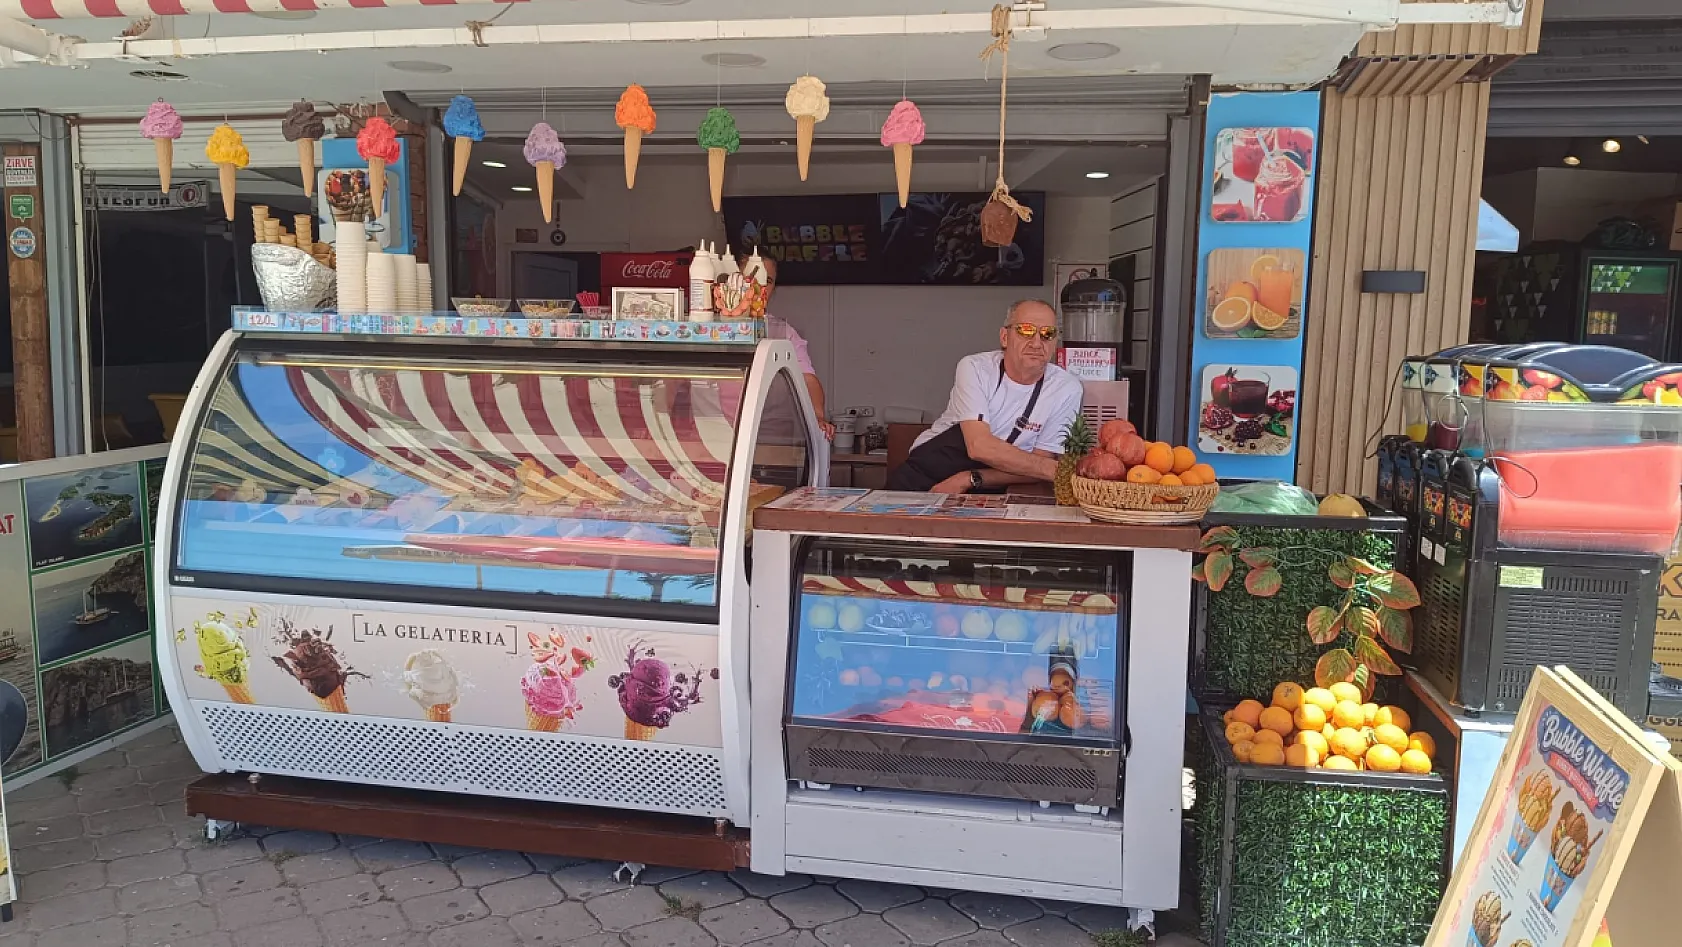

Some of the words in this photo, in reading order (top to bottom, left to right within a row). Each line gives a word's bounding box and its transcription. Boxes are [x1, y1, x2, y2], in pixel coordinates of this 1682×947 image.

[766, 224, 867, 242] BUBBLE
[364, 622, 388, 637] LA
[395, 624, 507, 647] GELATERIA
[1542, 714, 1585, 761] Bubble
[1583, 744, 1625, 810] Waffle
